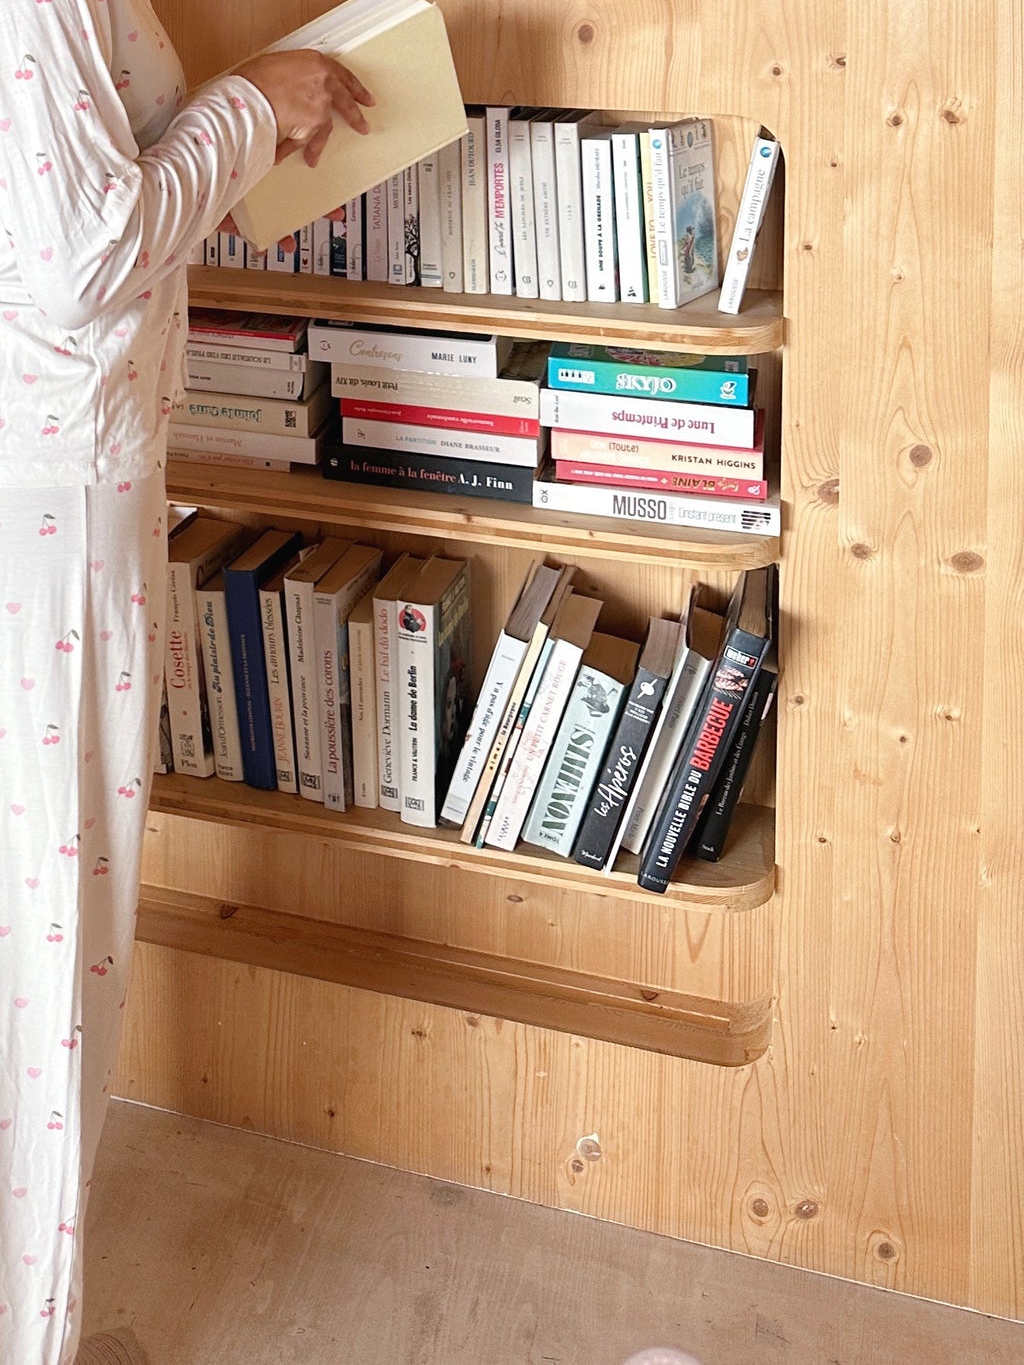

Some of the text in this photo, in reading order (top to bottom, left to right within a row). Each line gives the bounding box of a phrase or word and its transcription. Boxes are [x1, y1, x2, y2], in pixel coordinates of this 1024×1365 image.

[655, 152, 663, 166] fait
[468, 168, 477, 186] JEAN
[494, 162, 505, 219] M'EMPORTES
[373, 196, 382, 229] TATIANA
[657, 191, 667, 218] temps
[739, 168, 766, 242] La campagne
[657, 223, 667, 233] Le
[431, 352, 476, 364] MARIE LUNY
[335, 377, 348, 385] XIV
[615, 373, 677, 395] SKYJO
[189, 404, 261, 423] John le Carré
[612, 410, 715, 433] Lune de Printemps
[440, 440, 499, 452] DIANE BRASSEUR
[609, 442, 639, 453] (Toute)
[349, 460, 456, 482] la femme à la fenêtre
[671, 454, 756, 470] KRISTAN HIGGINS
[460, 474, 512, 490] A. J. Finn
[672, 477, 715, 491] BLAINE
[611, 494, 668, 520] MUSSO
[677, 507, 707, 520] L'instant
[707, 512, 736, 523] présent
[294, 593, 305, 663] Madeleine Chapsal
[378, 607, 388, 634] dodo
[203, 600, 223, 693] Au plaisir de Dieu
[263, 598, 280, 684] Les amours blessées
[169, 631, 186, 689] Cosette
[380, 651, 389, 667] bal
[380, 670, 390, 682] Le
[408, 665, 417, 730] La dame de Berlin
[489, 693, 498, 707] pas
[323, 650, 340, 773] La poussière des corons
[526, 660, 568, 761] UN PETIT CARNET ROUGE
[381, 691, 394, 785] Geneviève Dormann
[475, 727, 485, 746] pour
[219, 741, 228, 758] Jean
[462, 756, 478, 782] vintage
[542, 729, 596, 837] SIMENON
[594, 745, 638, 818] les Apéros
[656, 698, 734, 868] LA NOUVELLE BIBLE DU BARBECUE
